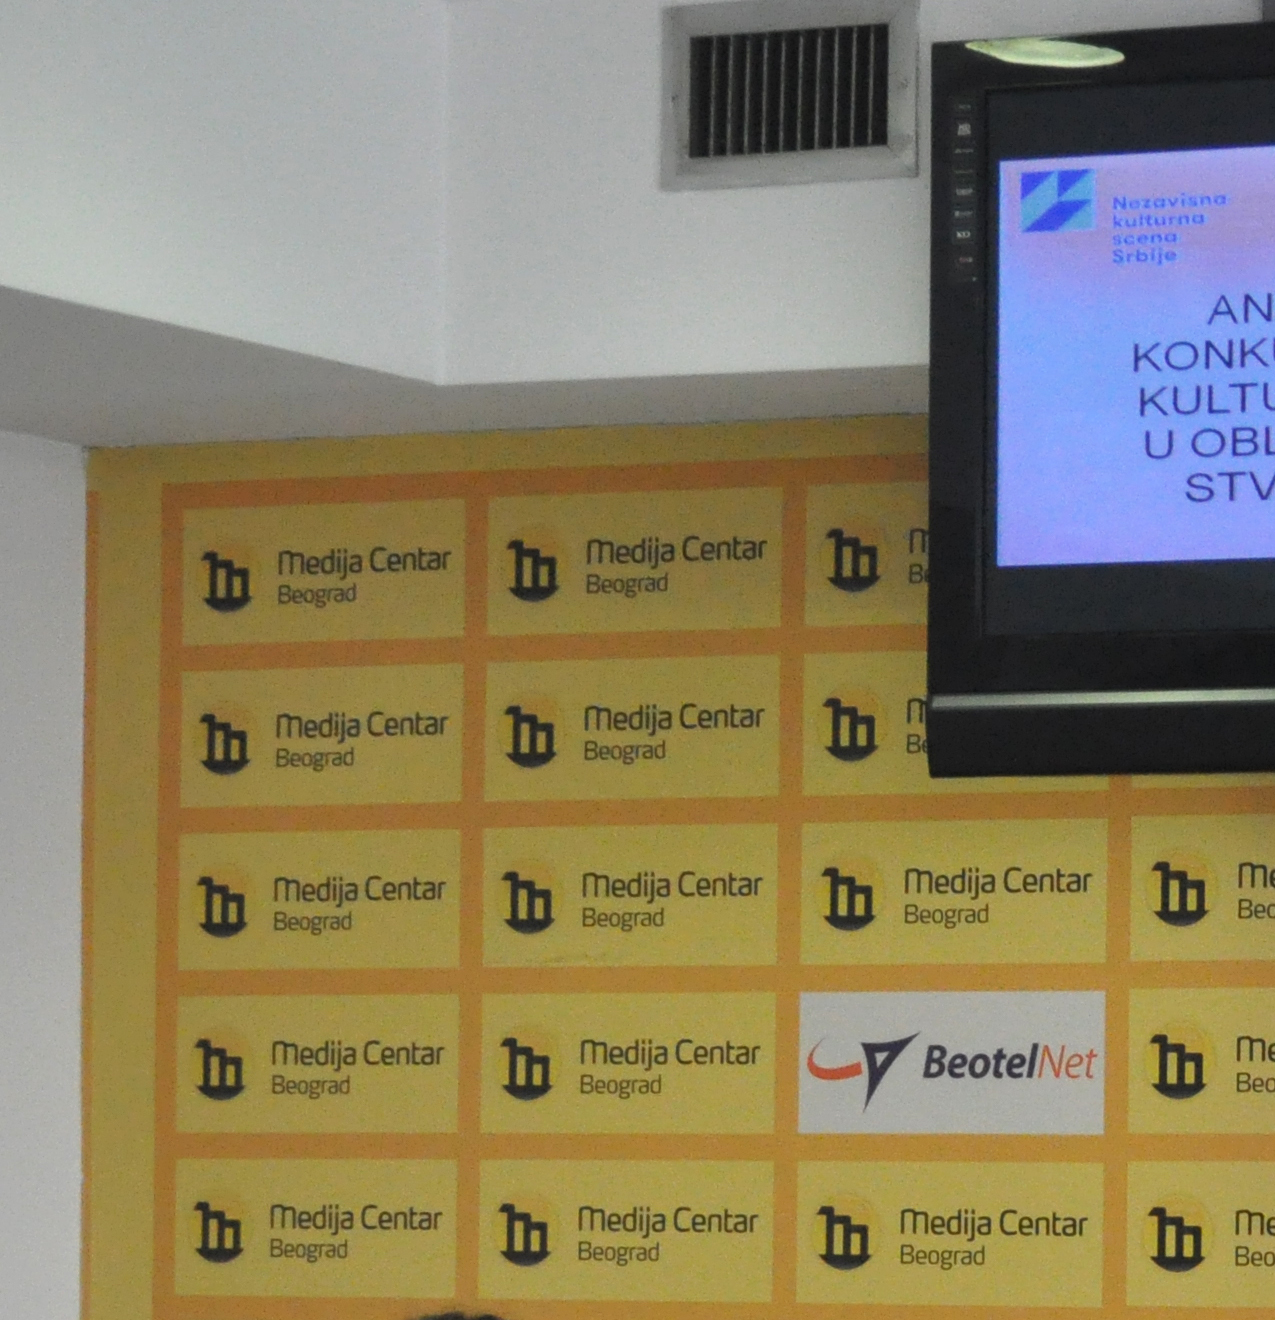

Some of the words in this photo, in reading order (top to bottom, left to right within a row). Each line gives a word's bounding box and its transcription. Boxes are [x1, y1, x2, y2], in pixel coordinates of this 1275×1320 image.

[1111, 191, 1230, 211] Nezavisna
[1112, 212, 1208, 229] kulturna
[1112, 231, 1180, 247] scena
[1112, 247, 1179, 267] Srbije
[1144, 430, 1174, 460] U
[278, 549, 363, 580] Medija
[369, 546, 451, 573] Centar
[586, 537, 676, 570] Medija
[682, 535, 767, 562] Centar
[278, 585, 356, 605] Beograd
[586, 574, 668, 597] Beograd
[276, 712, 361, 744] Medija
[366, 710, 448, 737] Centar
[584, 704, 673, 737] Medija
[679, 702, 765, 730] Centar
[276, 748, 354, 772] Beograd
[584, 740, 666, 765] Beograd
[273, 876, 359, 908] Medija
[364, 875, 446, 902] Centar
[904, 867, 996, 901] Medija
[1002, 866, 1093, 894] Centar
[273, 911, 352, 936] Beograd
[904, 904, 989, 929] Beograd
[580, 1038, 669, 1072] Medija
[674, 1038, 761, 1066] Centar
[922, 1042, 1098, 1080] BeotelNet
[580, 1074, 662, 1100] Beograd
[269, 1203, 355, 1236] Medija
[360, 1203, 443, 1231] Centar
[899, 1207, 993, 1243] Medija
[998, 1208, 1089, 1238] Centar
[270, 1238, 348, 1264] Beograd
[899, 1244, 986, 1271] Beograd
